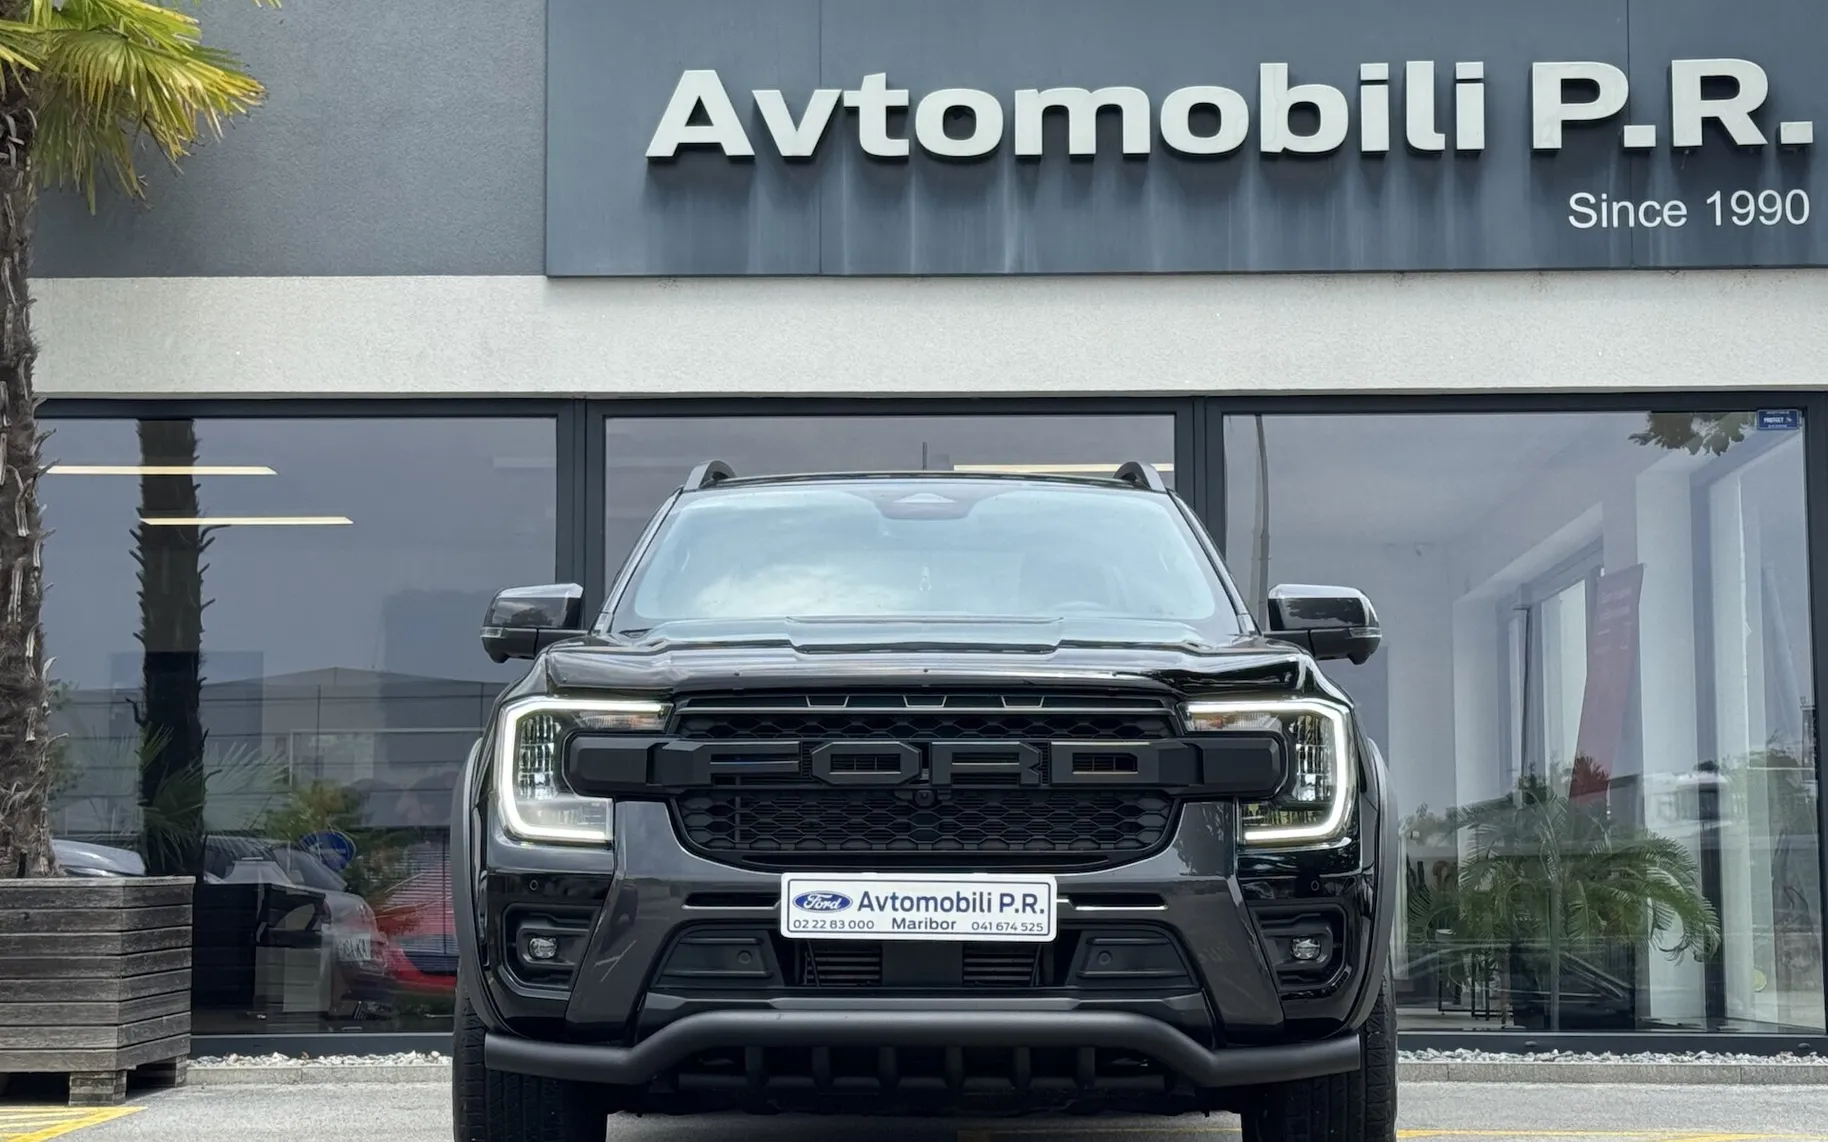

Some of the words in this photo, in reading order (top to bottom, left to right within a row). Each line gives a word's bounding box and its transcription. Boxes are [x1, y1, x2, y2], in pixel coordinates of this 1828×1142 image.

[646, 60, 1486, 158] Avtomobili
[1530, 58, 1814, 150] P.R.
[1567, 191, 1688, 230] Since
[1705, 189, 1811, 227] 1990
[802, 892, 842, 910] Ford
[857, 890, 992, 913] Avtomobili
[999, 892, 1045, 914] P.R.
[793, 919, 810, 929] 02
[811, 919, 828, 929] 22
[829, 919, 846, 929] 83
[848, 919, 875, 930] 000
[891, 917, 957, 931] Maribor
[971, 922, 993, 932] 041
[995, 922, 1018, 932] 674
[1020, 922, 1044, 932] 525
